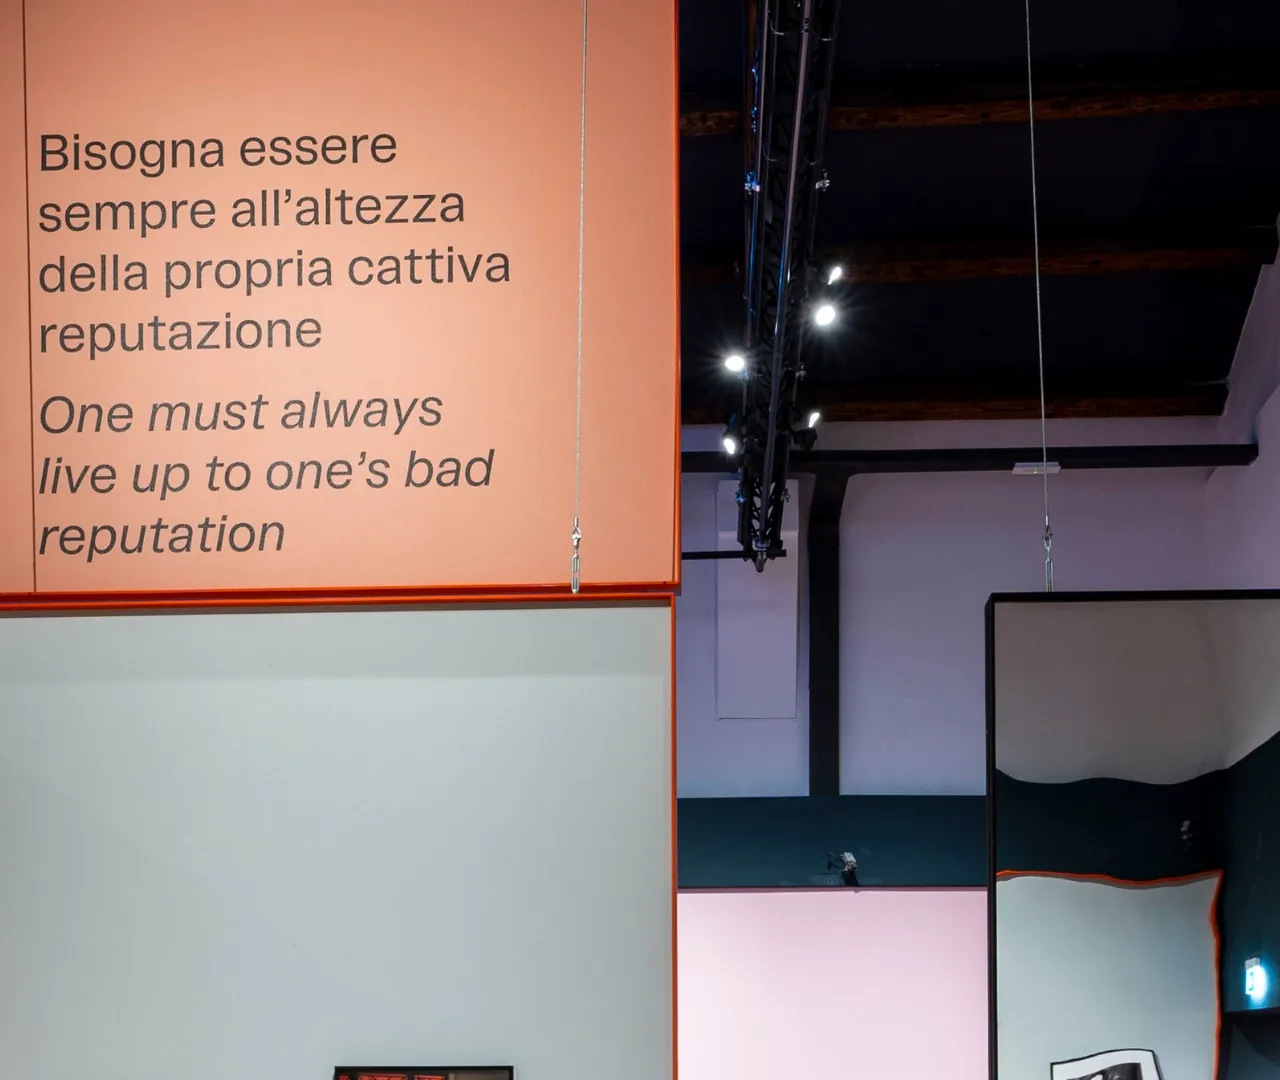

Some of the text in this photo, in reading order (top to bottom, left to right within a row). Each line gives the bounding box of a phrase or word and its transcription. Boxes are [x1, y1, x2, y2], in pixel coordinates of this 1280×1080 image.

[41, 133, 397, 178] Bisogna essere
[39, 188, 465, 238] sempre all’altezza
[39, 246, 510, 298] della propria cattiva
[40, 313, 322, 361] reputazione
[40, 392, 443, 436] One must always
[39, 448, 496, 501] live up to one’s bad
[39, 515, 285, 563] reputation
